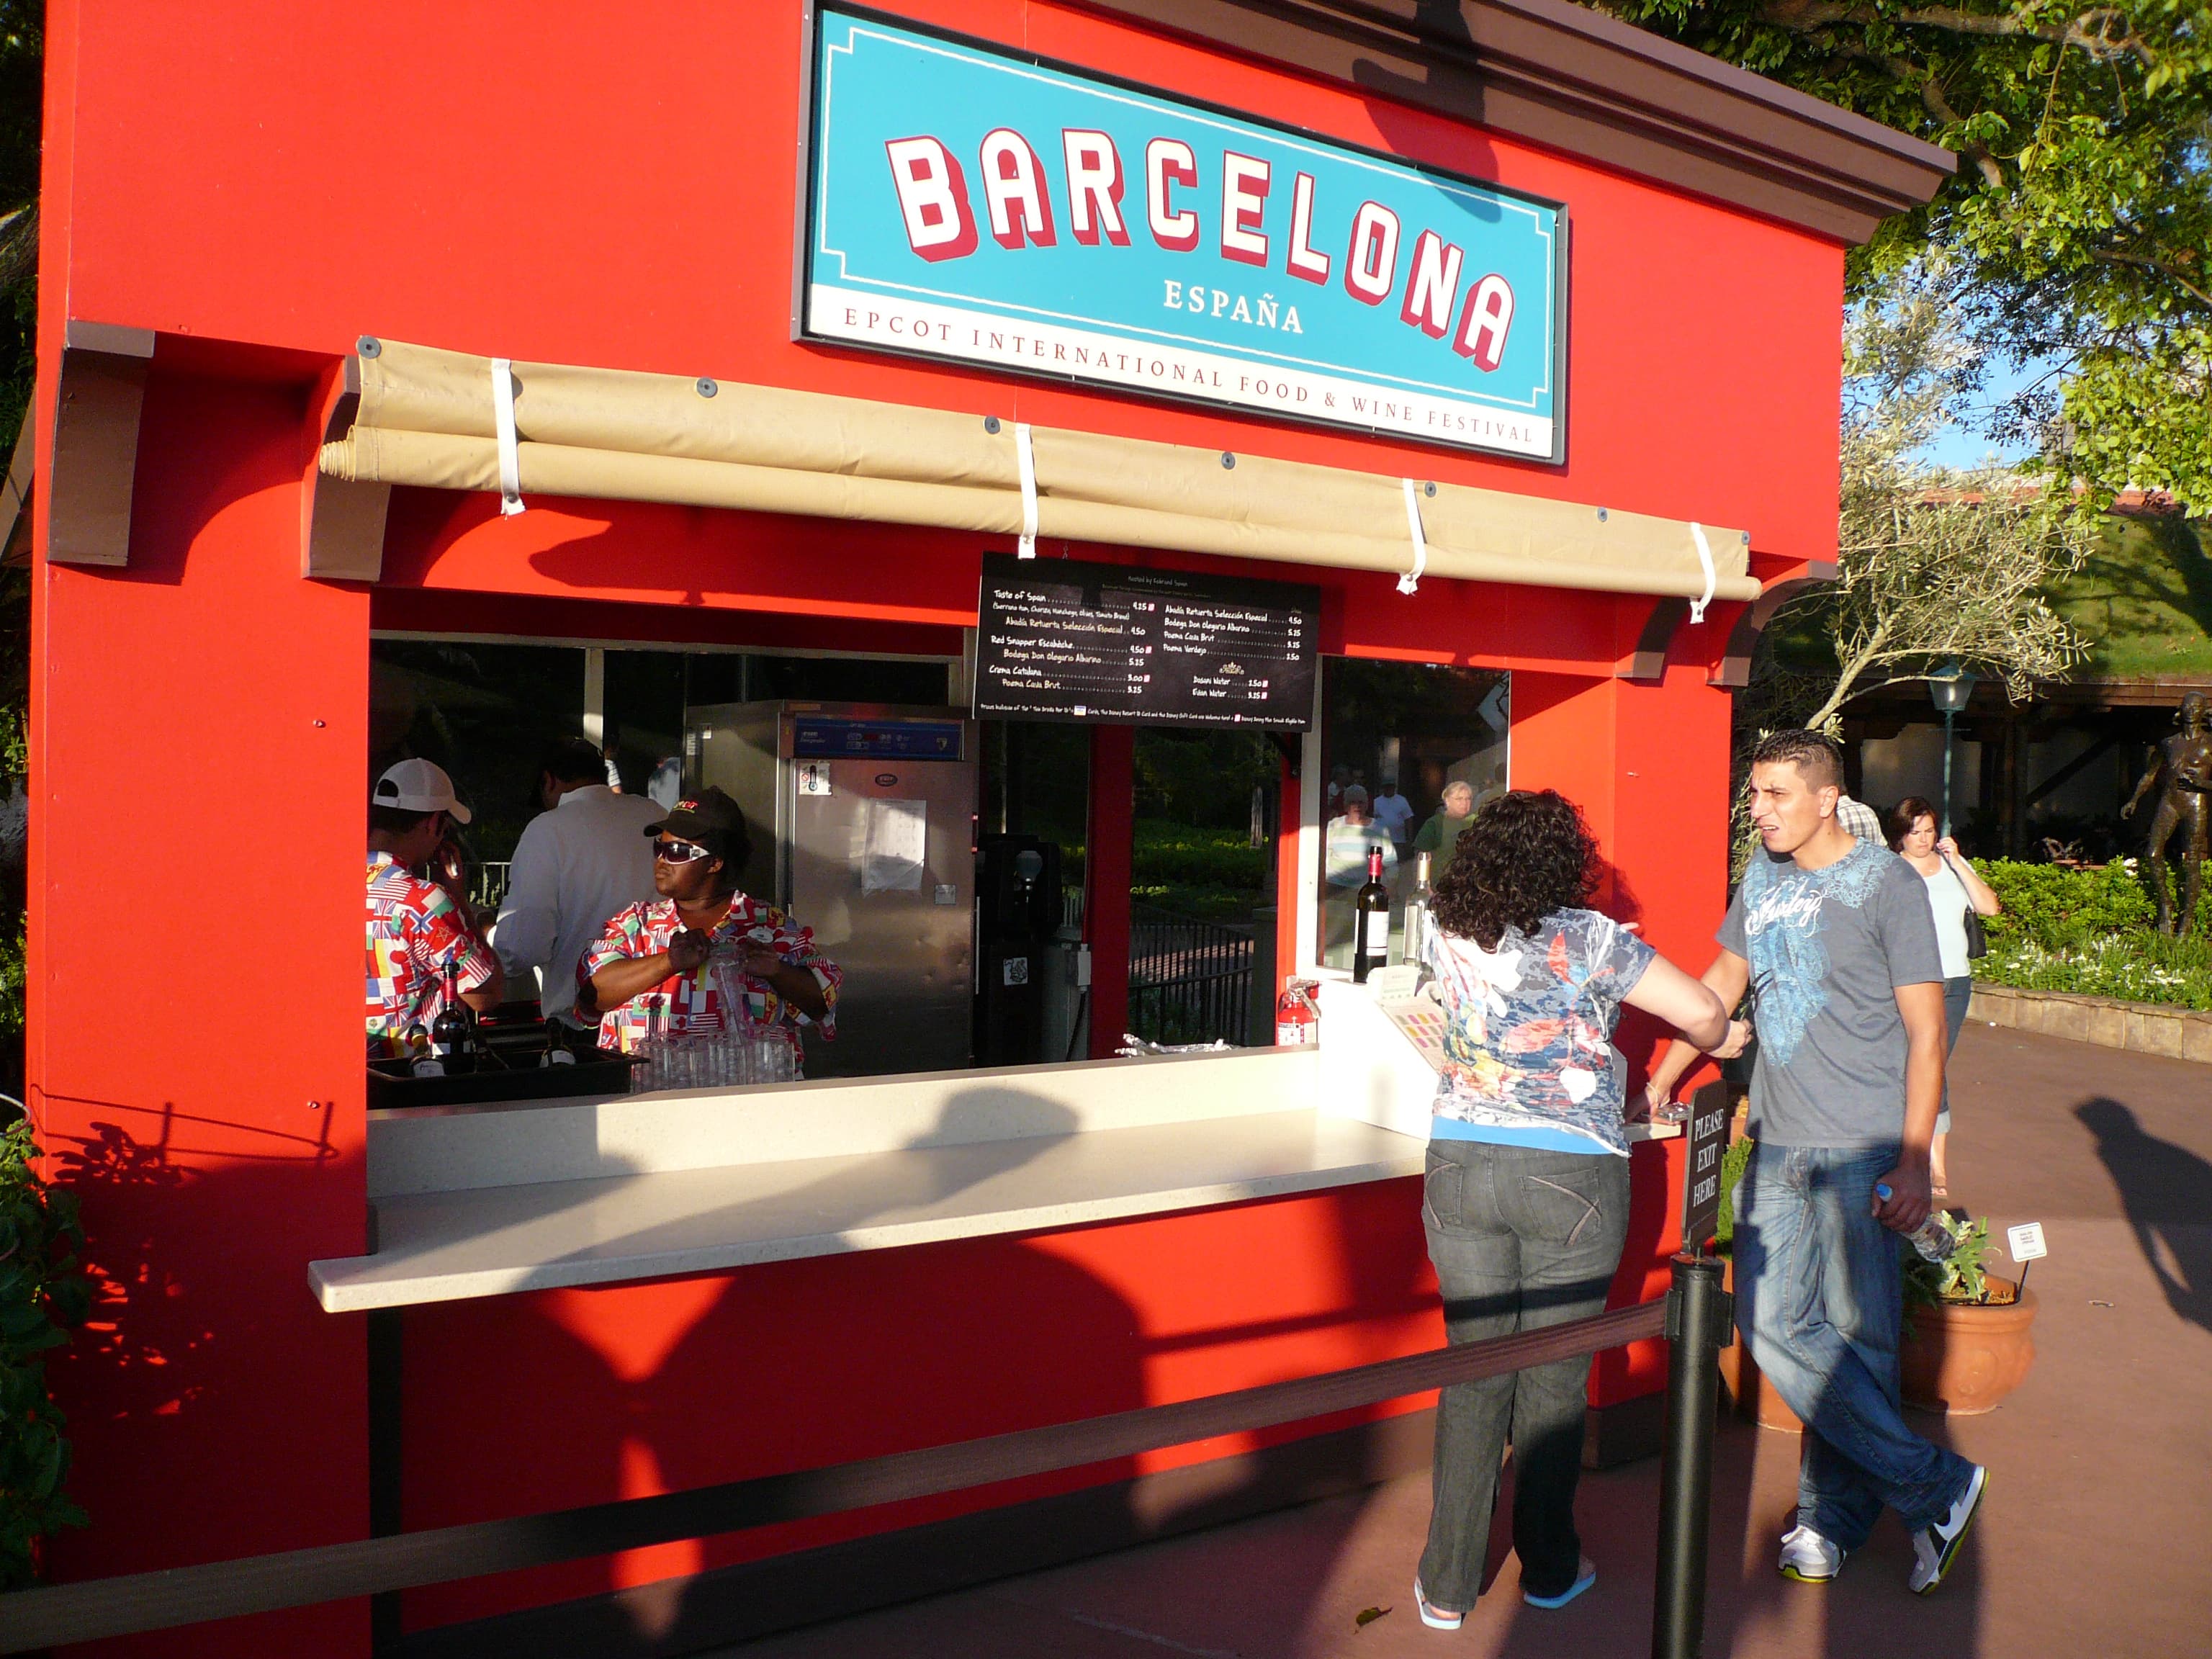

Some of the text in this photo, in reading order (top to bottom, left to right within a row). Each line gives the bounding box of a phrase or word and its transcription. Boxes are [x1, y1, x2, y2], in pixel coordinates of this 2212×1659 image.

[885, 127, 1514, 372] BARCELONA
[1164, 279, 1303, 334] ESPAÑA
[844, 307, 1532, 443] EPCOT INTERNATIONAL FOOD & WINE FESTIVAL
[993, 589, 1046, 603] Taste of Spain
[1186, 607, 1213, 617] Retuerta
[1245, 612, 1267, 622] Especial
[1029, 619, 1060, 629] Retuerta
[1097, 624, 1123, 634] Especial
[1164, 617, 1187, 629] Bodega
[1189, 620, 1200, 629] Don
[991, 635, 1004, 644] Red
[1007, 636, 1037, 647] Snapper
[1164, 631, 1183, 640] Poema
[1200, 633, 1215, 642] Brut
[1004, 648, 1029, 662] Bodega
[1031, 651, 1045, 660] Don
[989, 664, 1042, 677] Crema Catalana
[1002, 678, 1024, 688] Poema
[1044, 680, 1061, 689] Brut
[1694, 1108, 1724, 1142] PLEASE
[1697, 1142, 1717, 1173] EXIT
[1694, 1175, 1717, 1208] HERE
